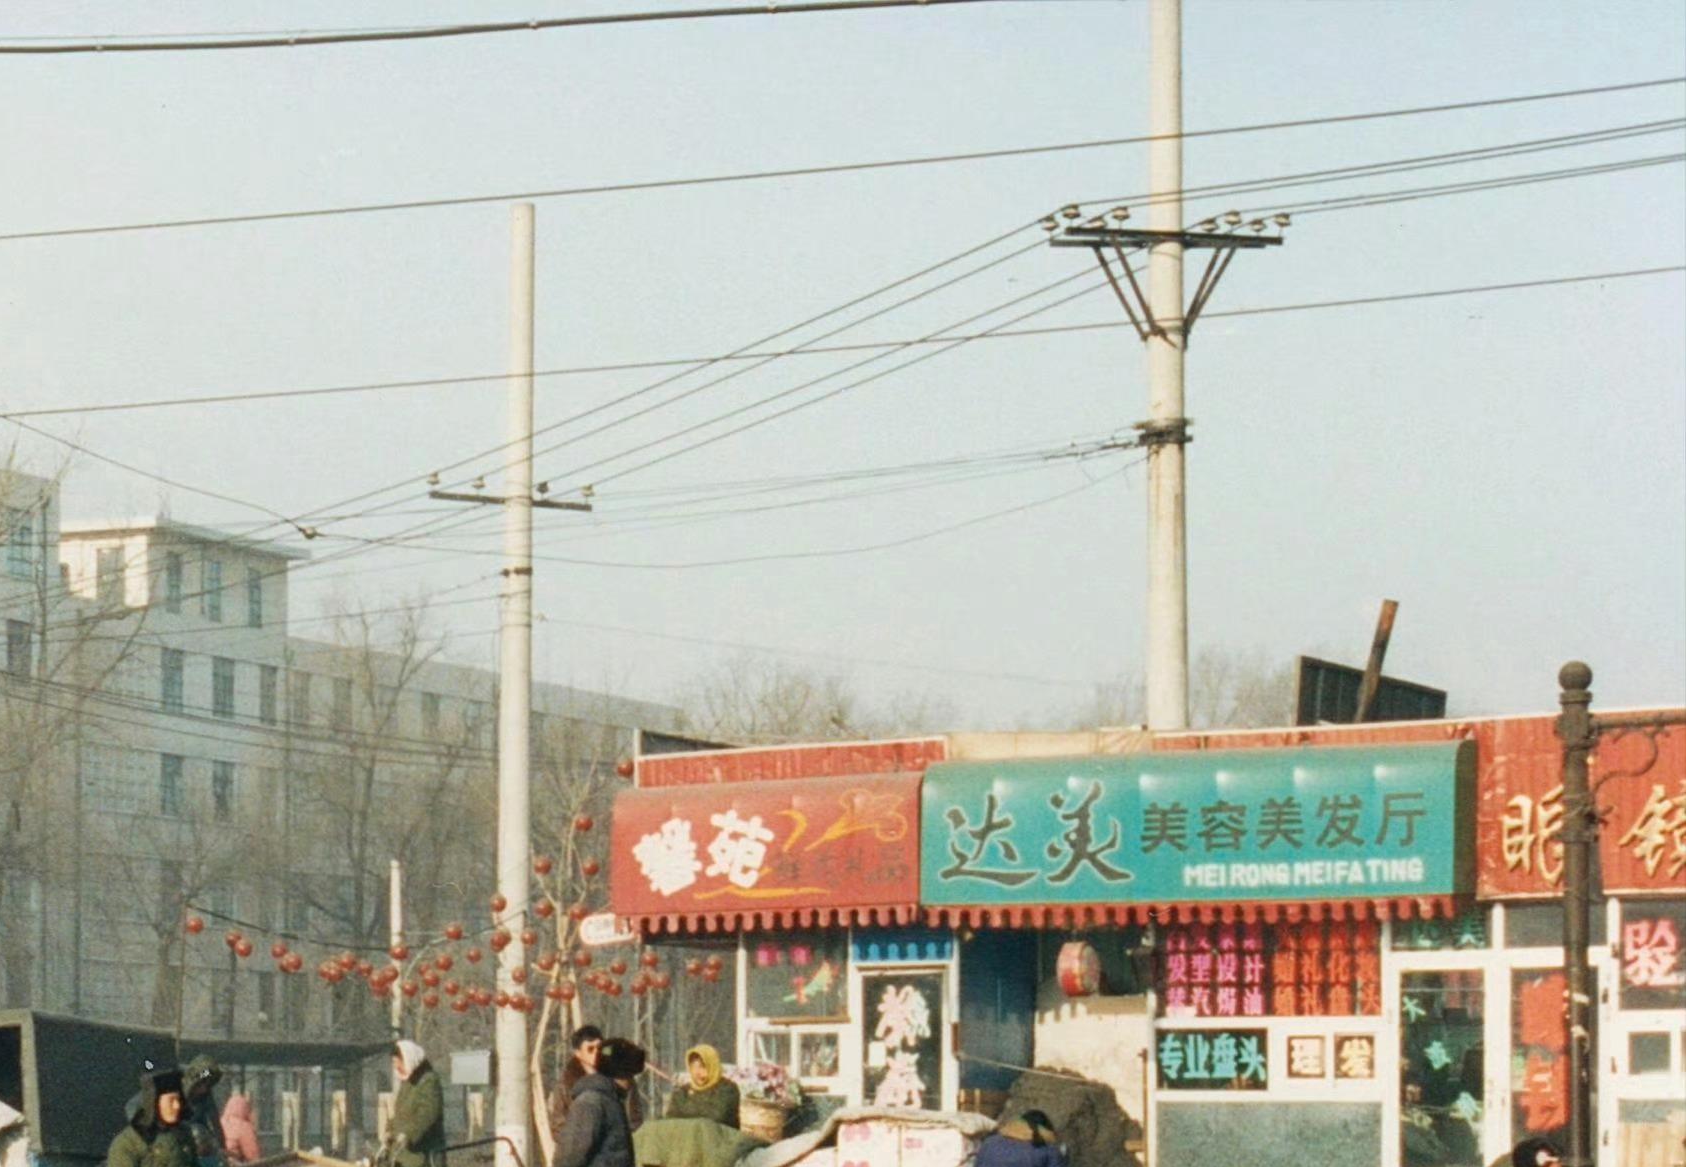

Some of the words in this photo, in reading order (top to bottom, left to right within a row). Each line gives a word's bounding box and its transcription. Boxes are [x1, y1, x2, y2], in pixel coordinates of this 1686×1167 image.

[1140, 792, 1427, 853] 美容美发厅
[1183, 865, 1226, 887] MEI
[1228, 863, 1291, 886] RONG
[1365, 858, 1425, 883] TING
[1158, 1033, 1267, 1081] 专业盘头
